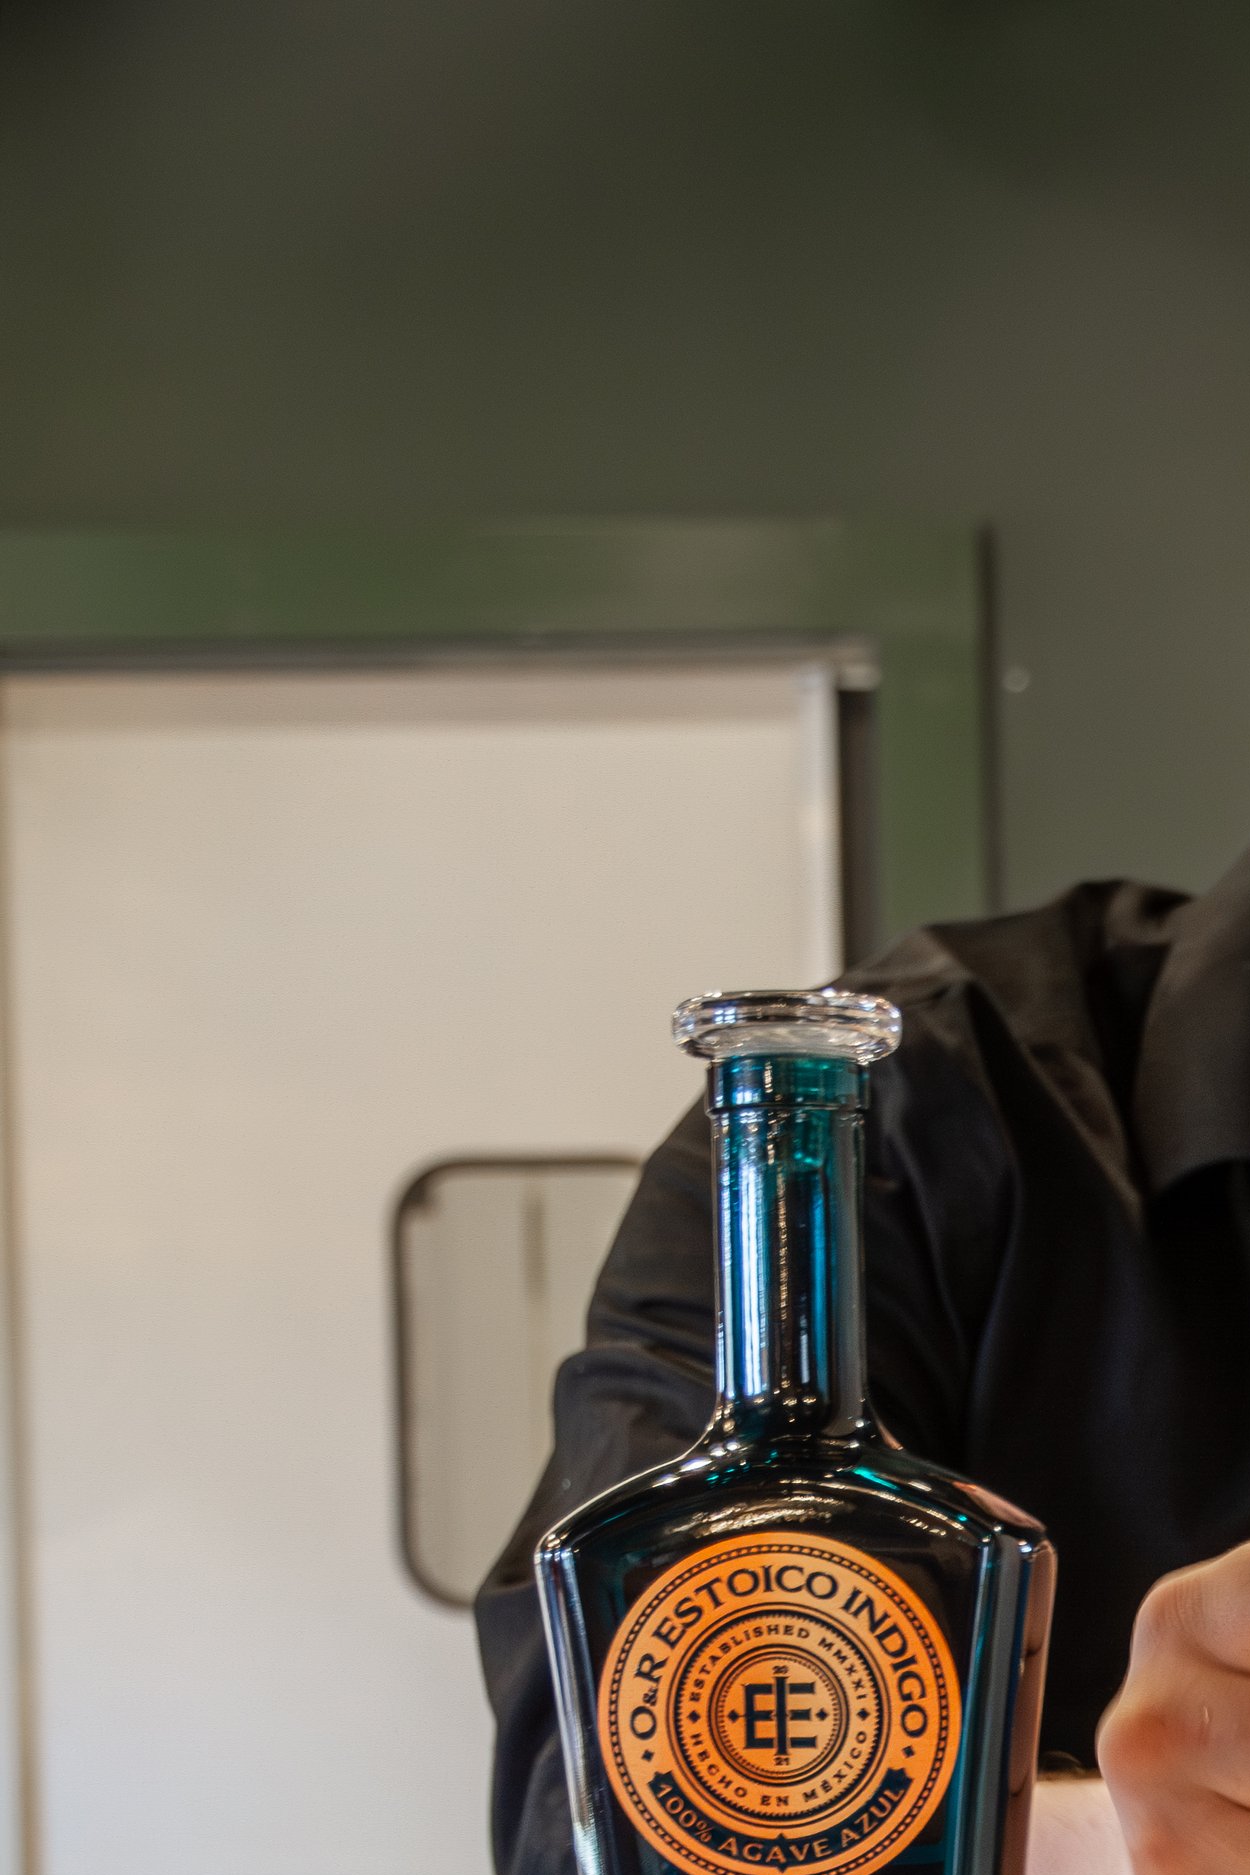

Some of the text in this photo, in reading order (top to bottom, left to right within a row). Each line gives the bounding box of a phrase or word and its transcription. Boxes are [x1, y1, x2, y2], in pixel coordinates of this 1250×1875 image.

[629, 1564, 928, 1741] O&R ESTOICO INDIGO
[690, 1624, 868, 1702] ESTABLISHED MMXXI
[690, 1730, 868, 1807] HECHO EN MÉXICO
[656, 1781, 906, 1865] 100% AGAVE AZUL
